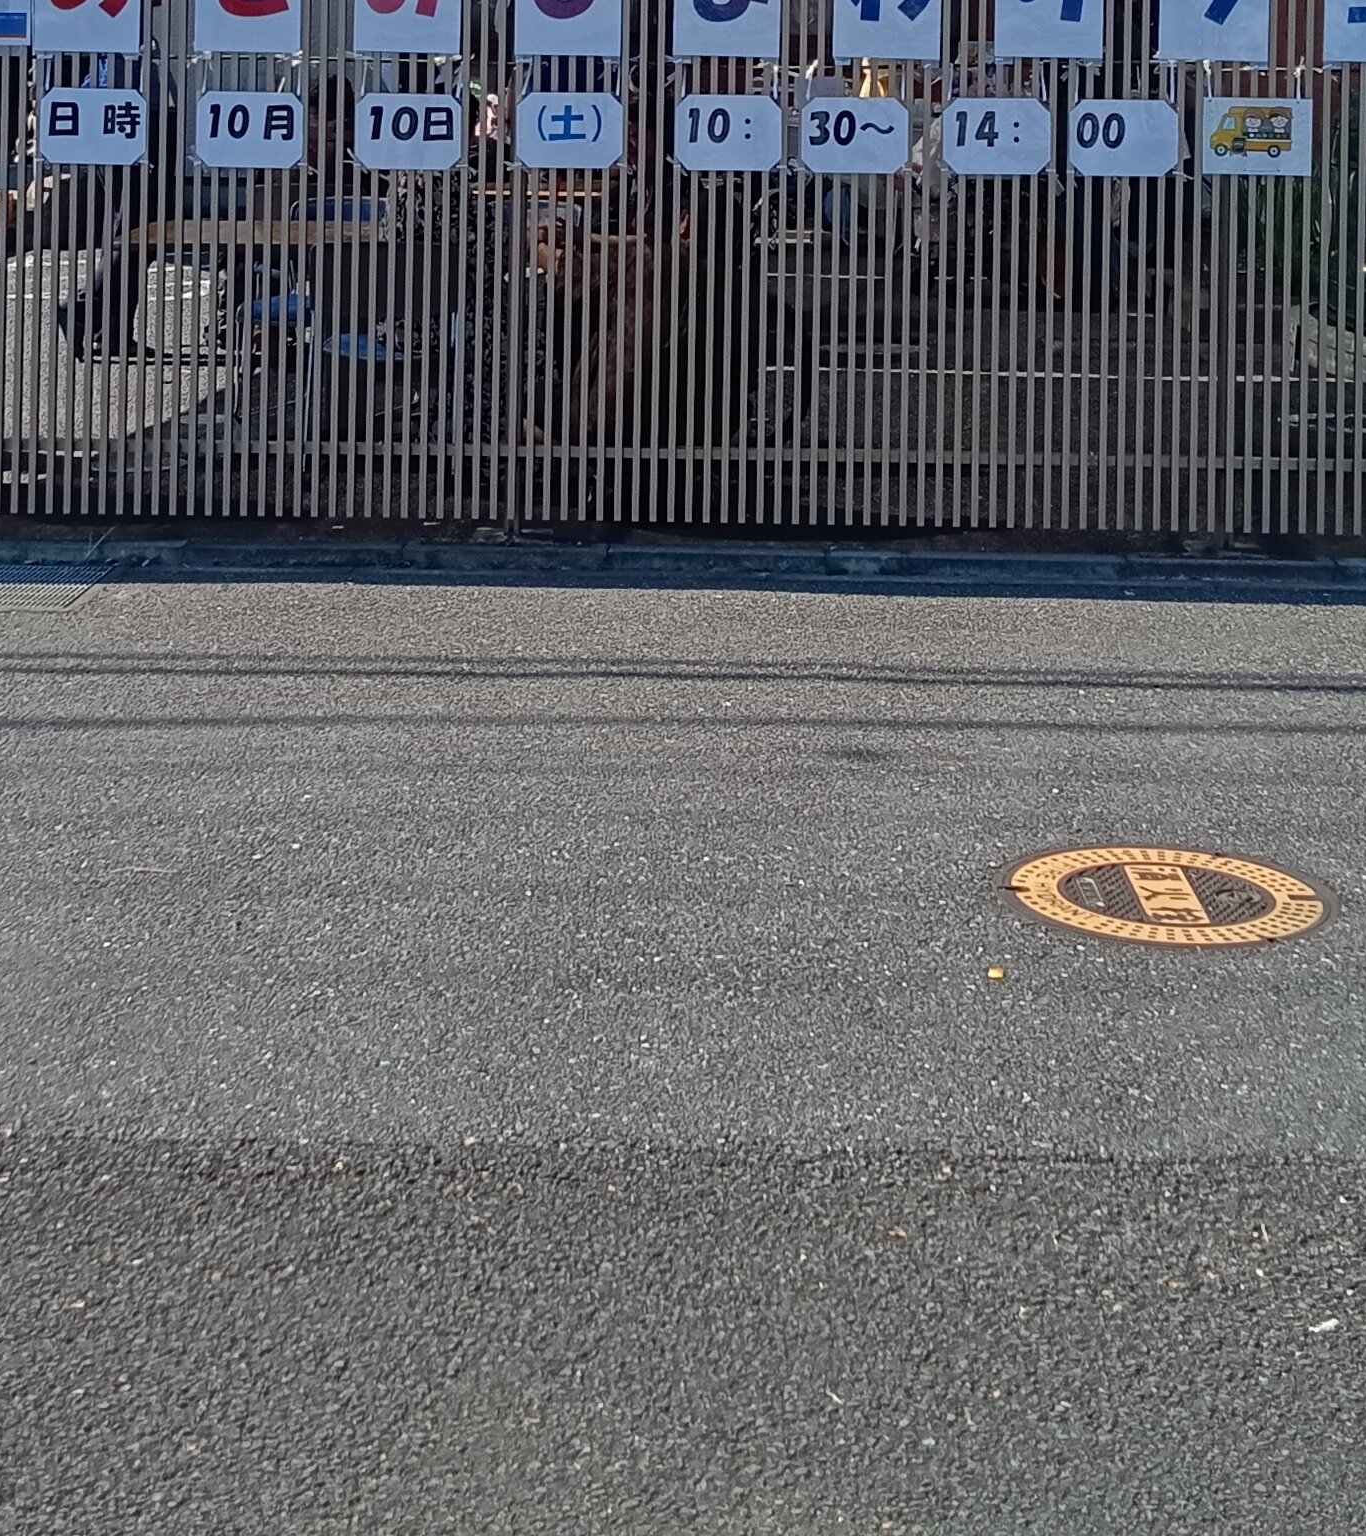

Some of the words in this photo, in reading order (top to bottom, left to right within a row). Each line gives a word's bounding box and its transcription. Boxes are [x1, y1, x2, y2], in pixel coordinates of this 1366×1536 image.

[48, 100, 141, 140] 日時
[208, 103, 295, 141] 10月
[370, 105, 455, 142] 10日
[537, 104, 603, 143] (土)
[1076, 112, 1126, 150] 00
